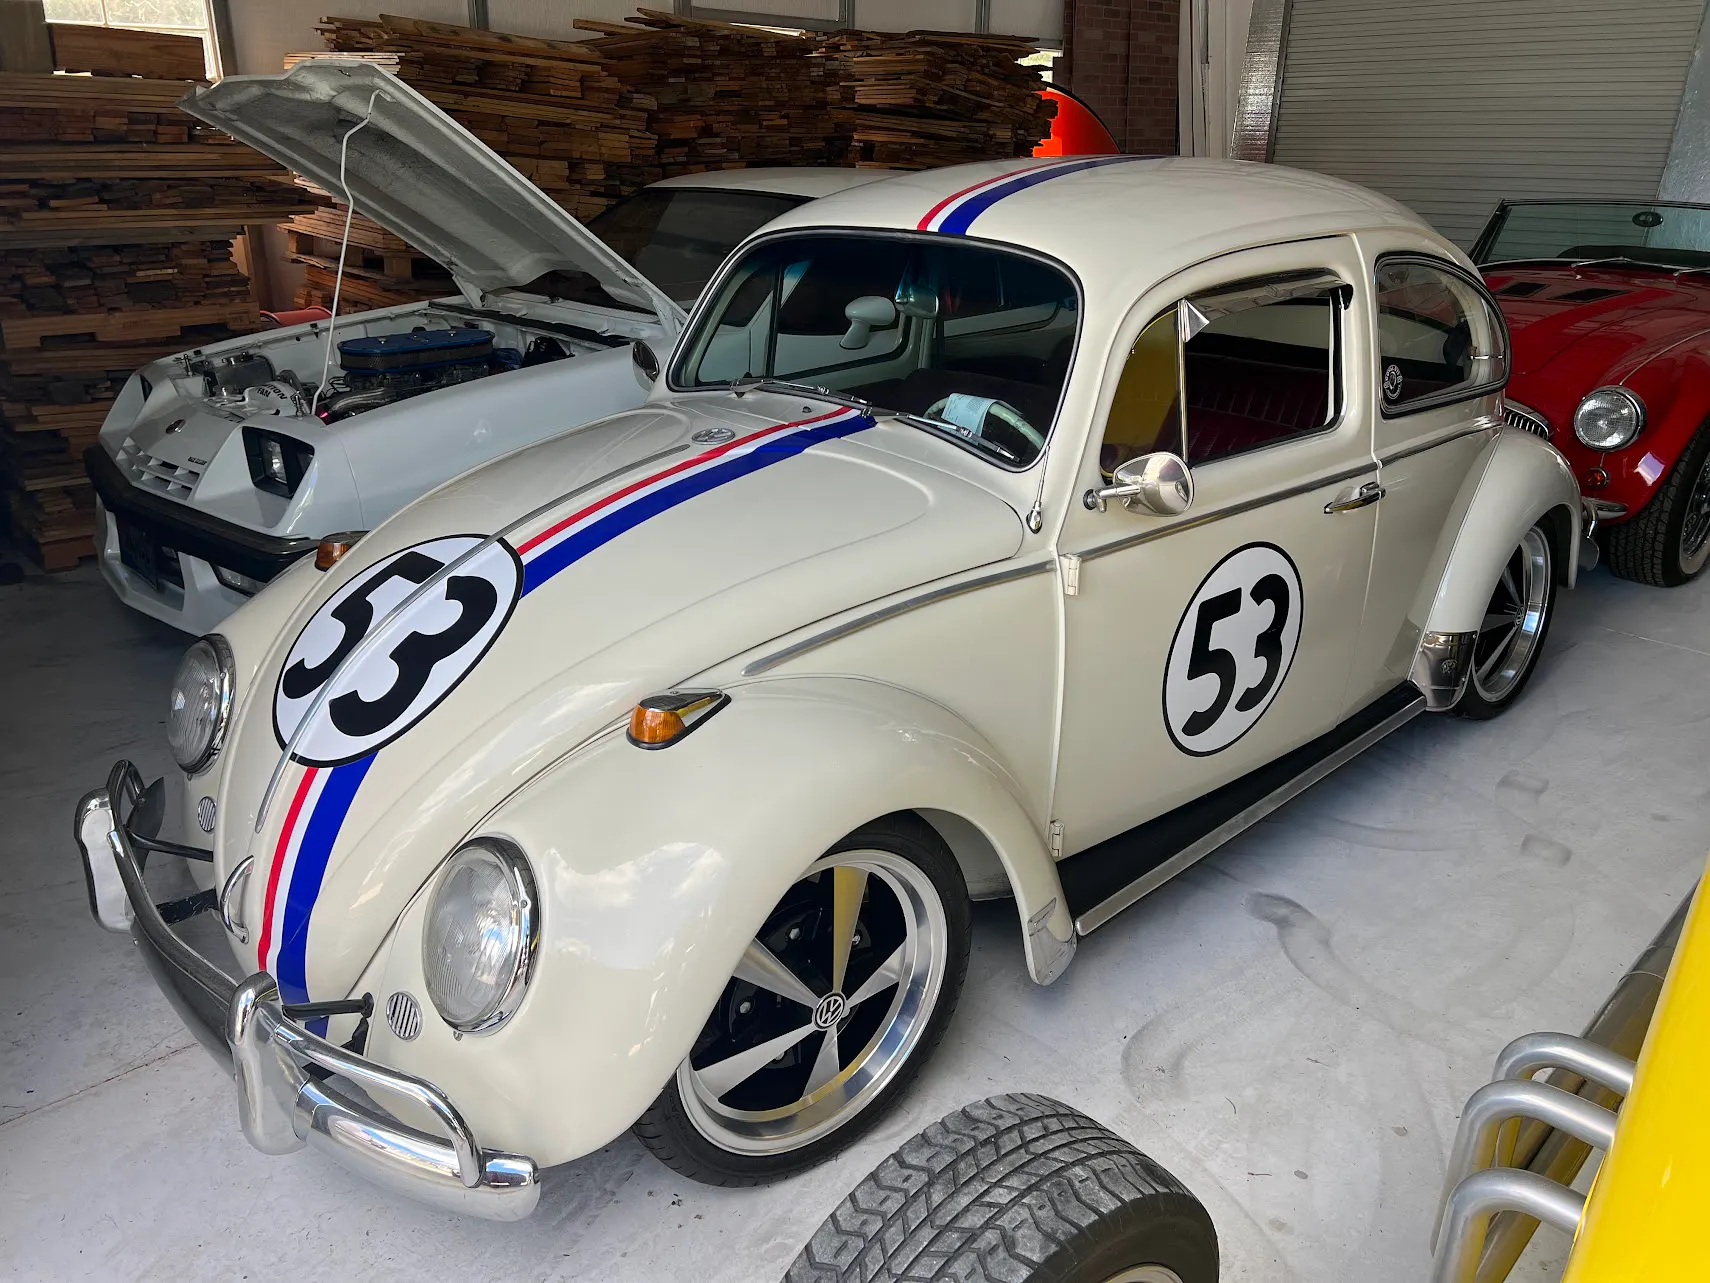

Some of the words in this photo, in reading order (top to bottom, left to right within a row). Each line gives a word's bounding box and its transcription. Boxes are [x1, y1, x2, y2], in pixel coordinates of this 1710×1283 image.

[283, 551, 498, 737] 53
[1181, 573, 1290, 737] 53
[817, 996, 843, 1027] VW
